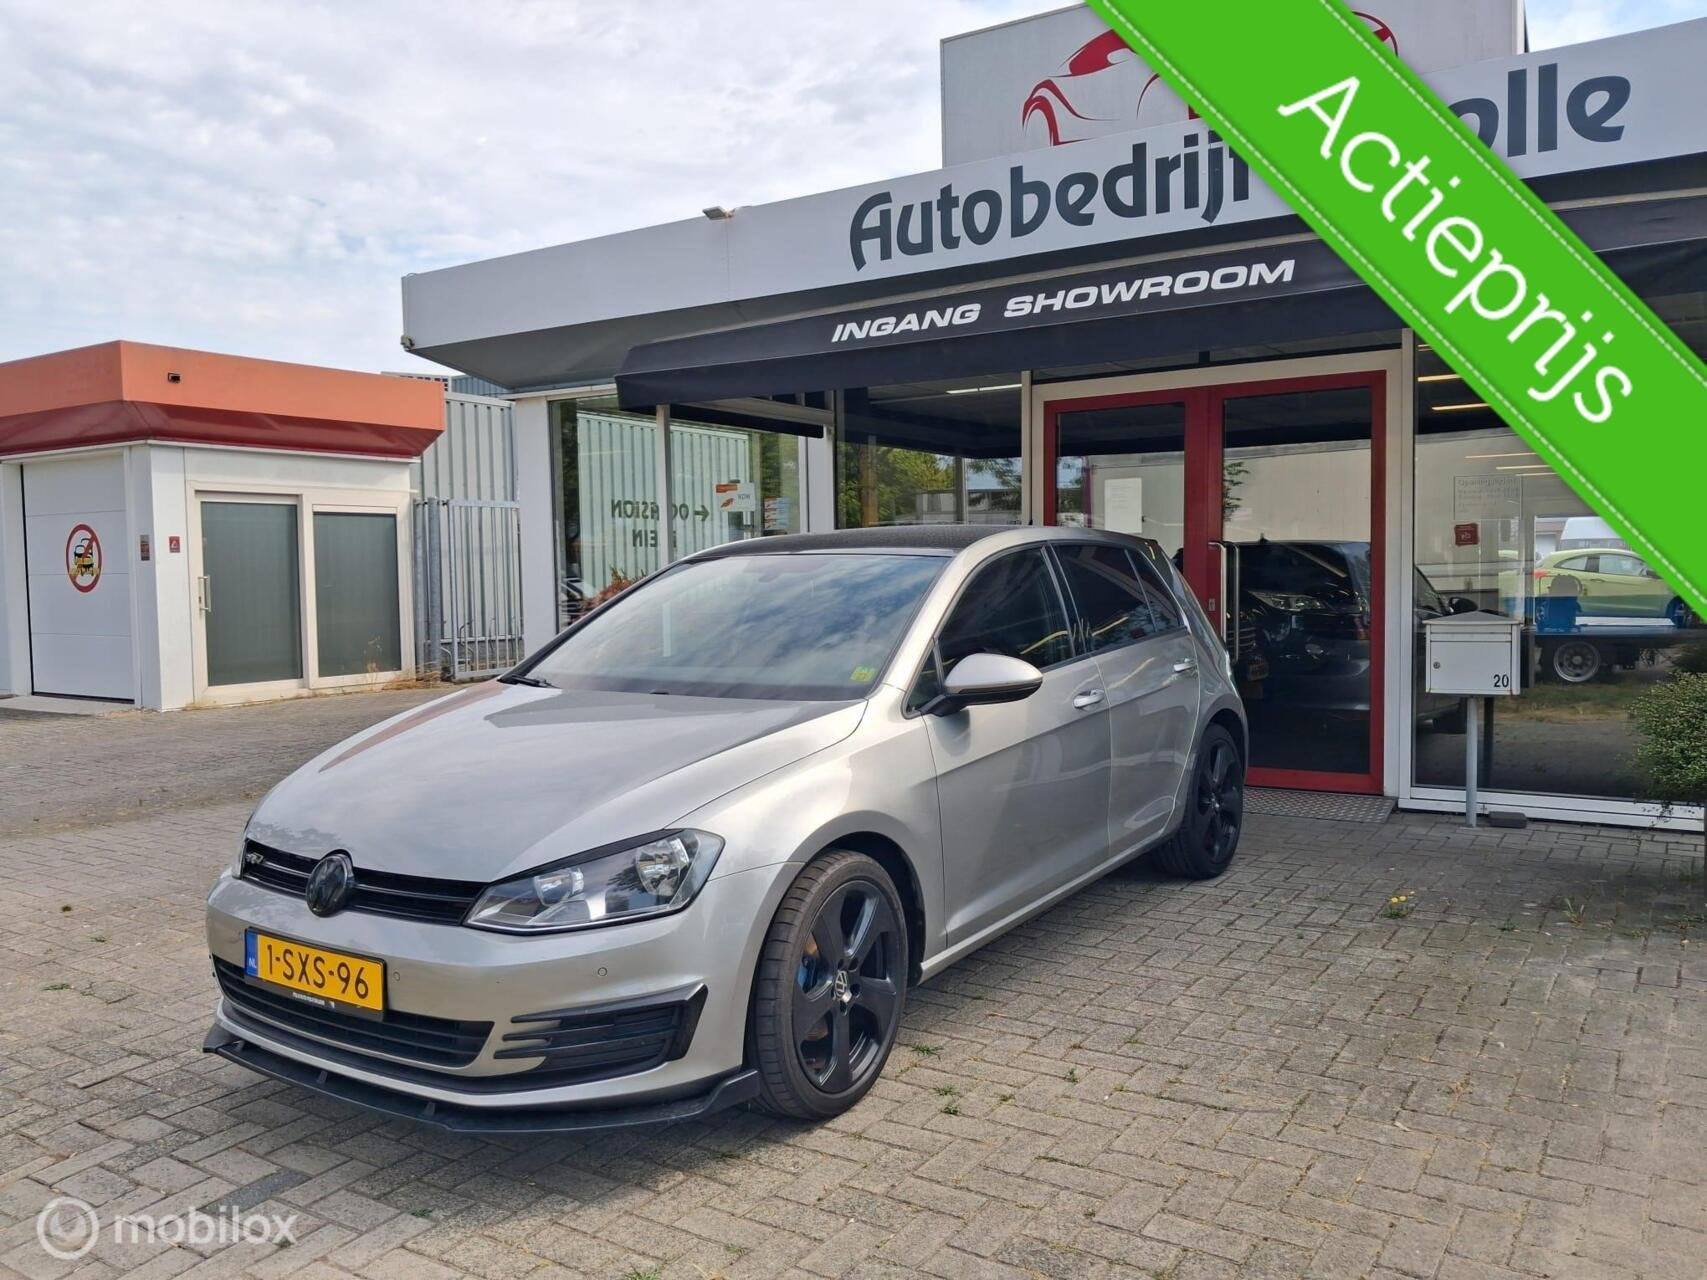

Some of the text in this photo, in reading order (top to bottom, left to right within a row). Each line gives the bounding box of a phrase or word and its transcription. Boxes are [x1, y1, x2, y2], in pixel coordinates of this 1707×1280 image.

[831, 259, 1296, 343] INGANG SHOWROOM
[1493, 674, 1510, 688] 20
[267, 944, 369, 1000] 1-SXS-96
